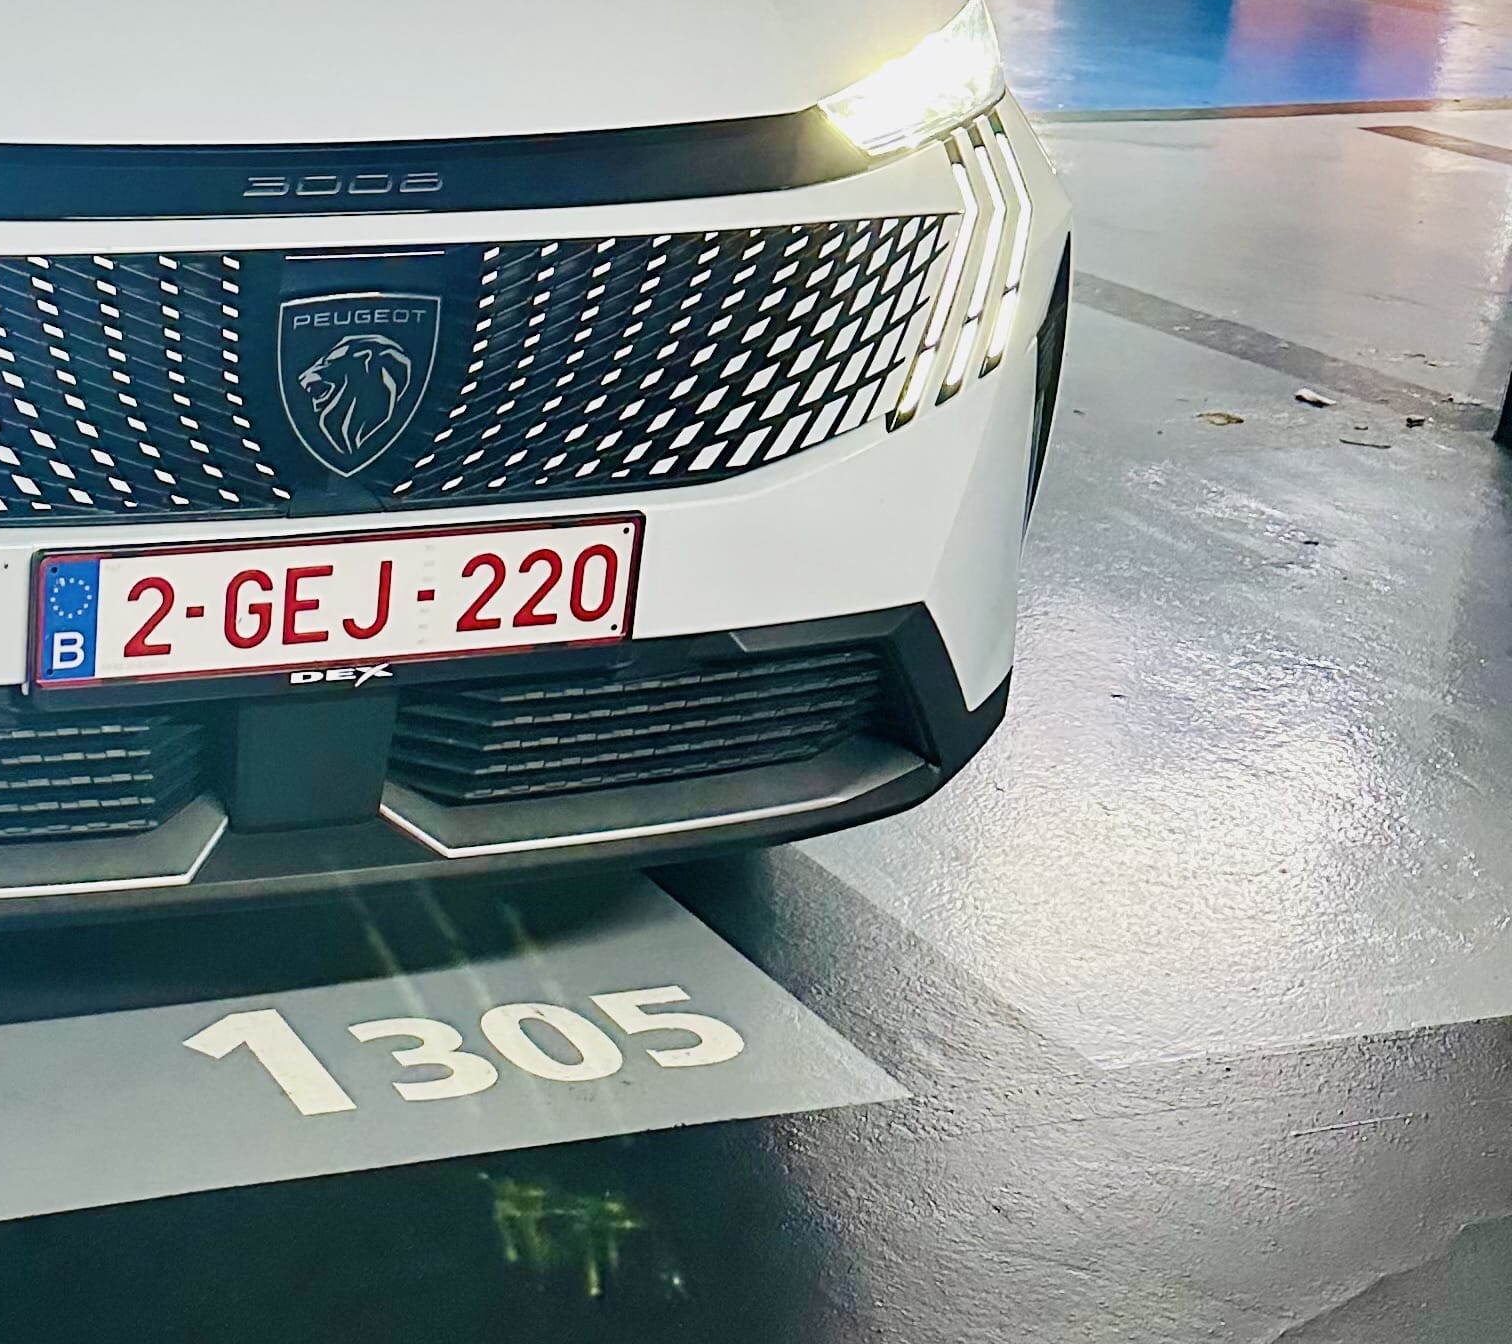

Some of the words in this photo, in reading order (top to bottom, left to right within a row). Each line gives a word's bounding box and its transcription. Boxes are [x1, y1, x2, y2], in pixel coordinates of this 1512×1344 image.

[243, 172, 443, 197] 3008
[292, 309, 428, 330] PEUGEOT
[50, 631, 86, 672] B
[123, 544, 619, 658] 2-GEJ-220
[290, 663, 393, 688] DEX
[182, 984, 745, 1116] 1305
